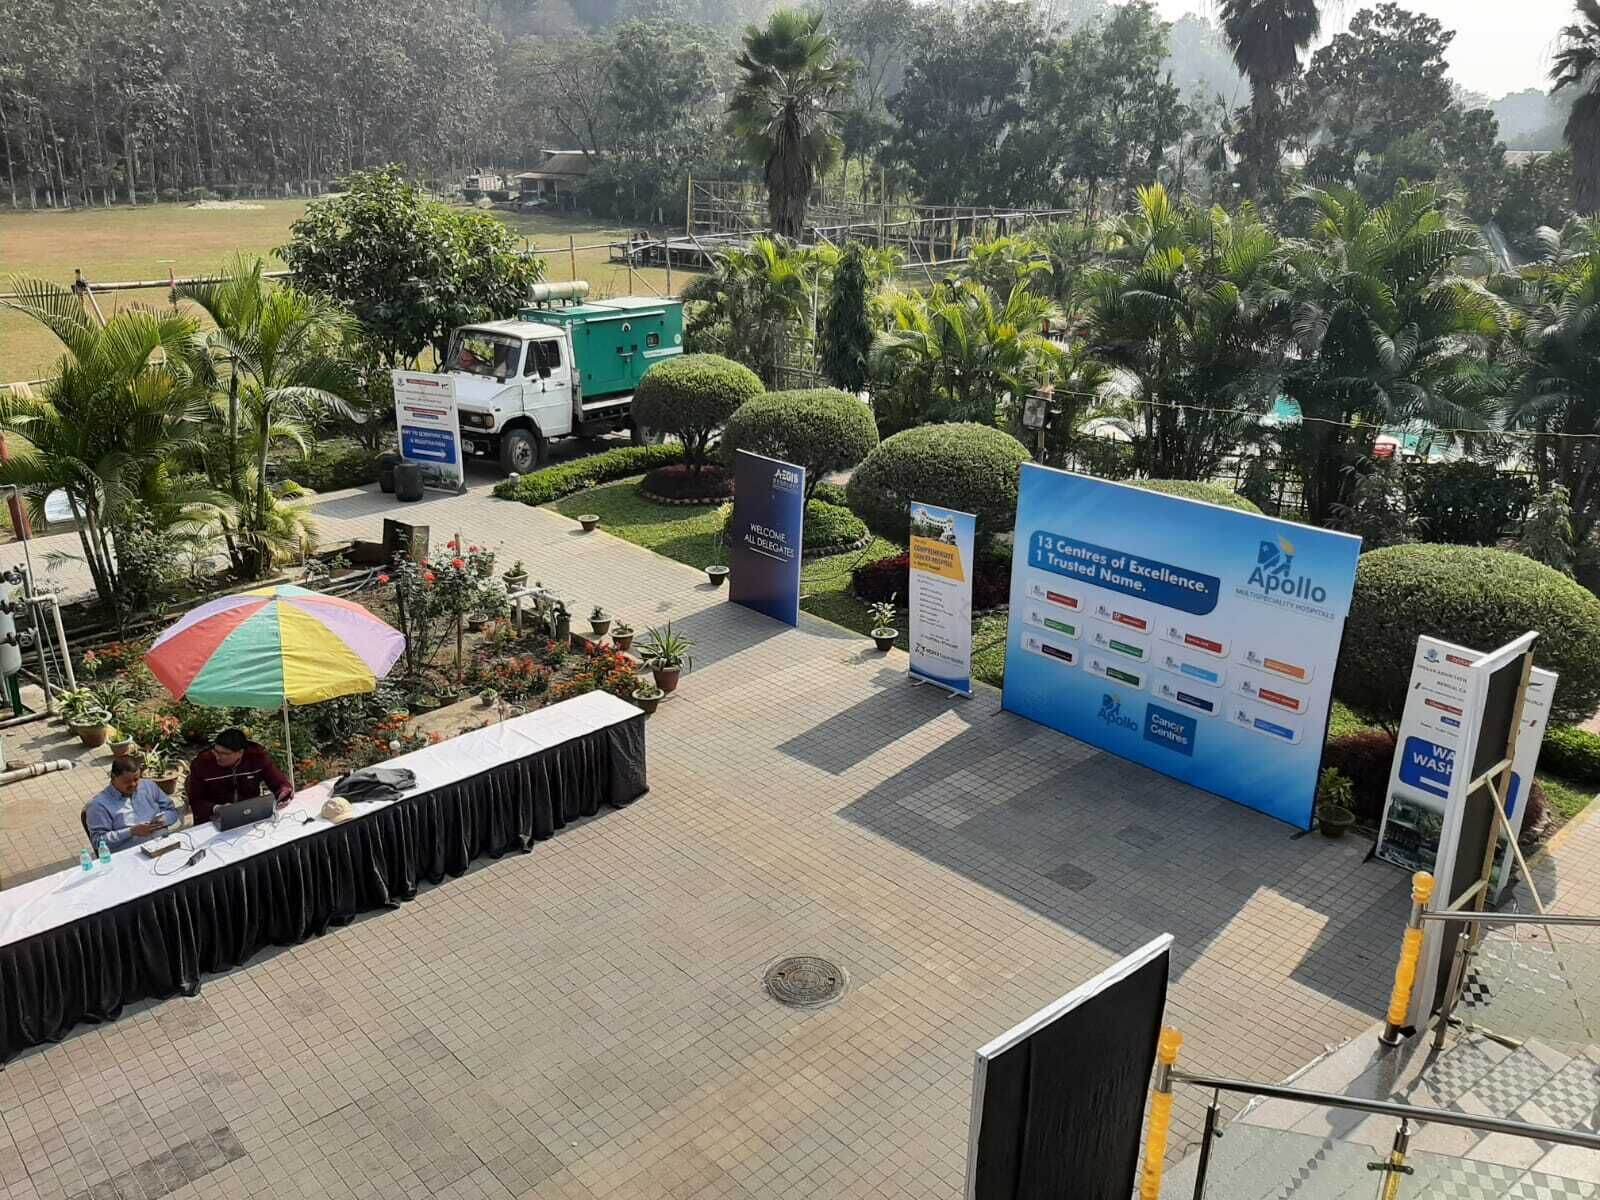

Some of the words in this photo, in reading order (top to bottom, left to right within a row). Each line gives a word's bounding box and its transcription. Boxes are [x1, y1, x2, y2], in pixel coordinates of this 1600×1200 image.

[744, 534, 758, 545] ALL
[757, 537, 795, 558] DELEGATES
[1036, 549, 1043, 562] 1
[1047, 553, 1096, 577] Trusted
[1099, 568, 1146, 592] Name.
[1037, 535, 1053, 550] 13
[1056, 541, 1107, 565] Centres
[1111, 556, 1125, 570] of
[1129, 561, 1209, 594] Excellence.
[1247, 566, 1326, 603] Apollo
[1097, 707, 1138, 732] Apollo
[1150, 725, 1188, 745] Centres
